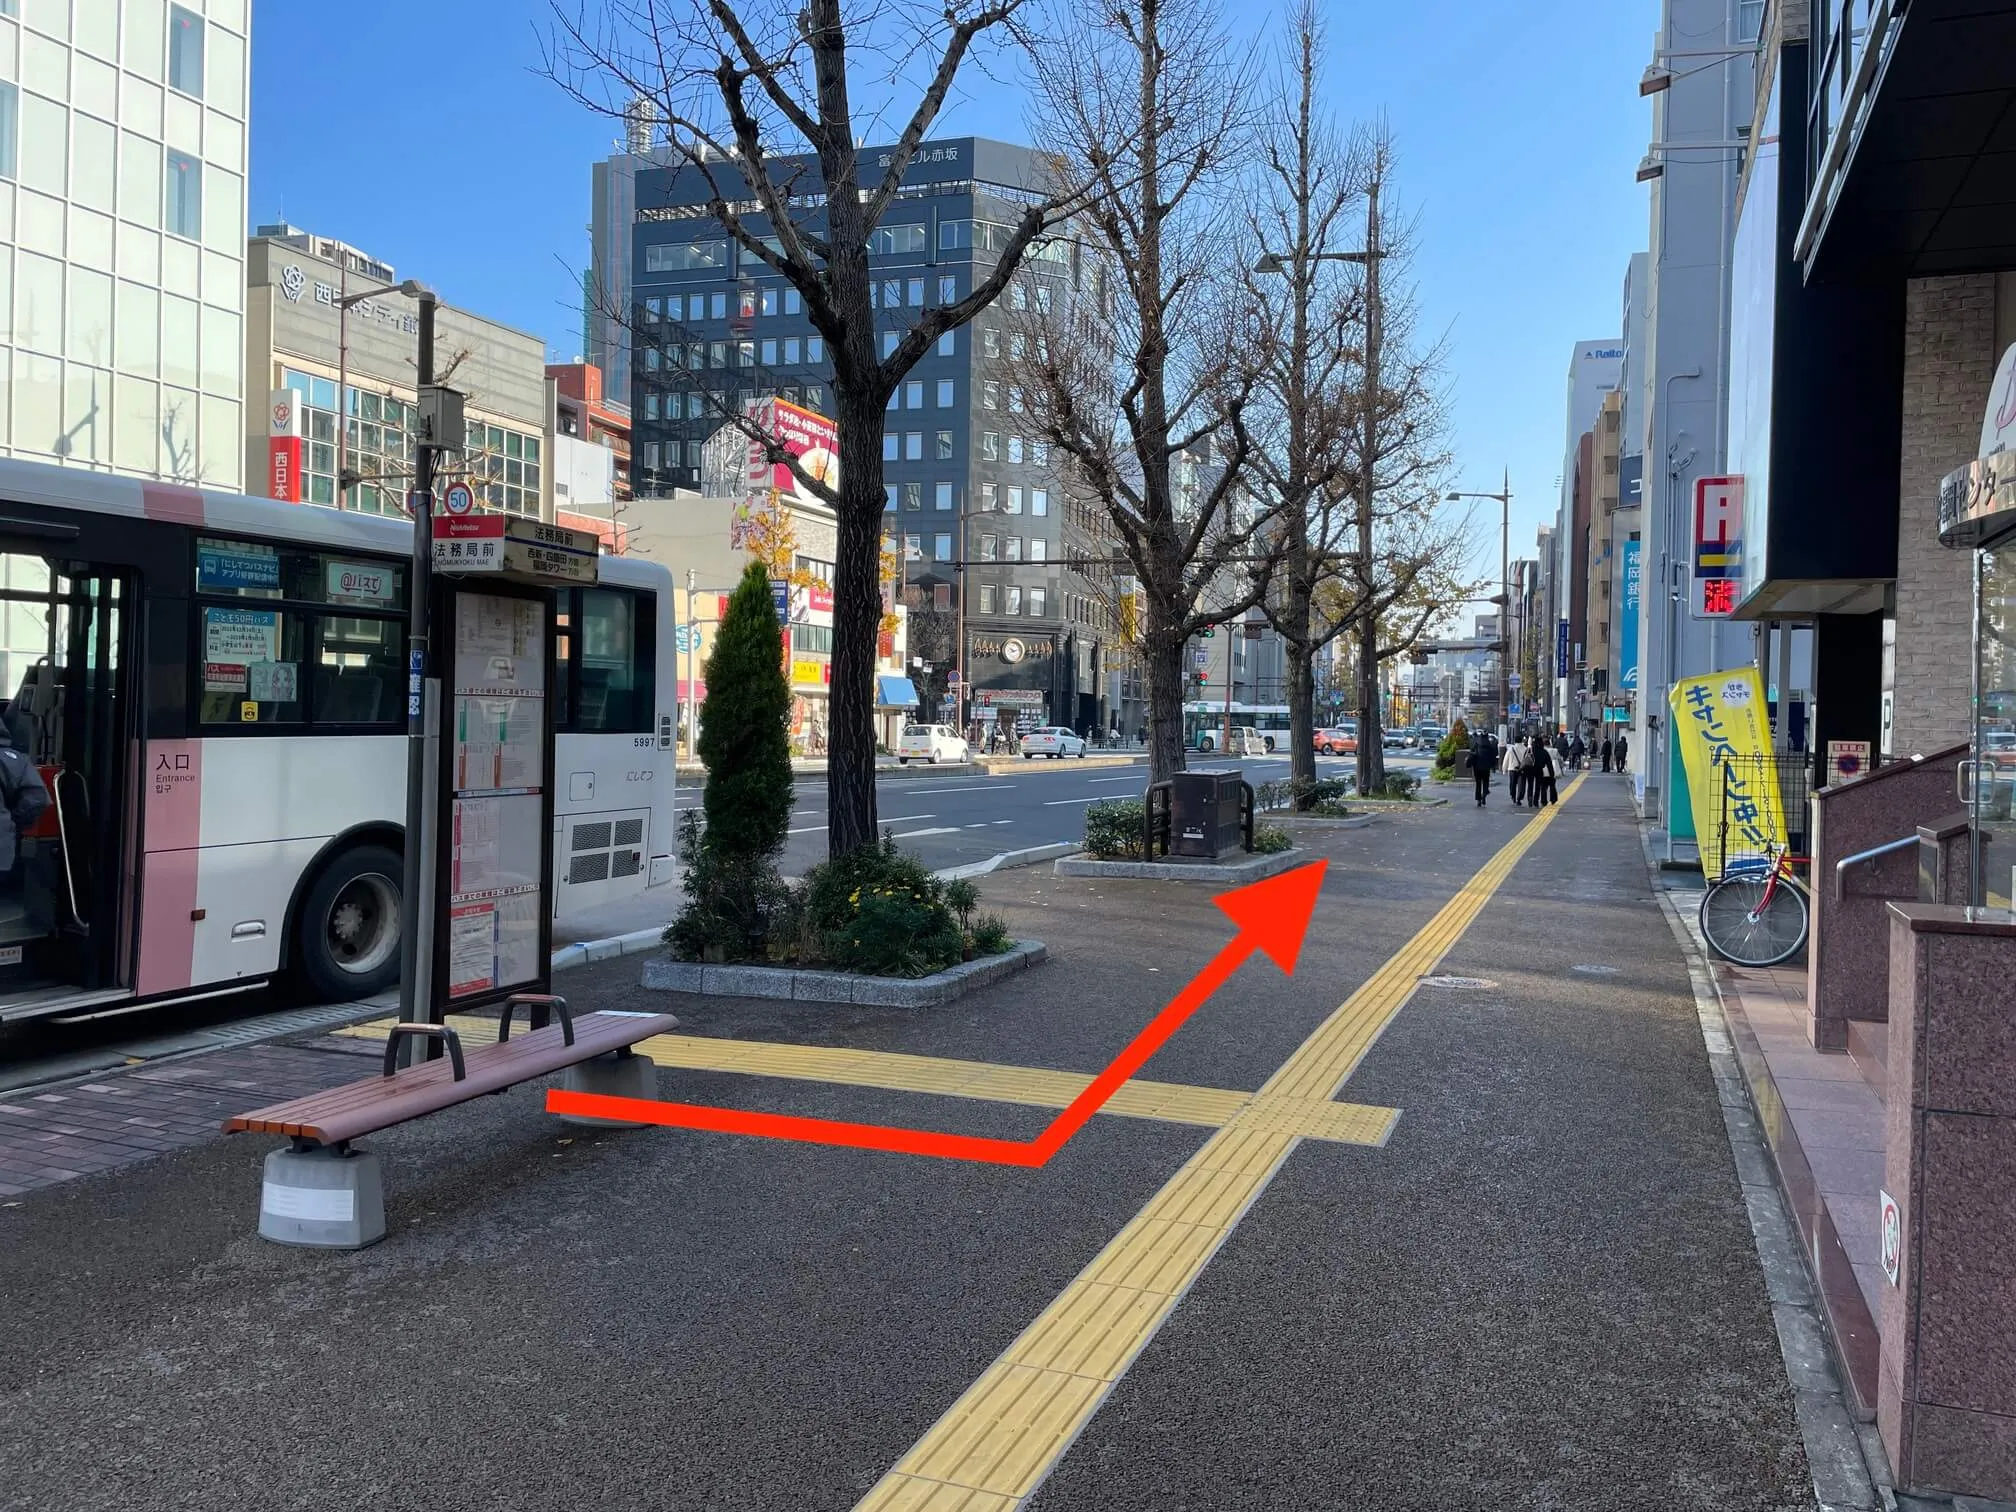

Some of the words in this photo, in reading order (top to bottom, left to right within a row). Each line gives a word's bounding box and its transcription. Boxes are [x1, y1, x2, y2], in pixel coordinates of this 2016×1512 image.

[275, 451, 288, 499] 西日本
[450, 492, 467, 508] 50
[534, 526, 574, 546] 法務局前
[434, 542, 495, 557] 法務局前
[634, 737, 655, 747] 5997
[156, 753, 190, 770] 入口
[156, 774, 196, 783] Entrance
[156, 784, 172, 794] 입구
